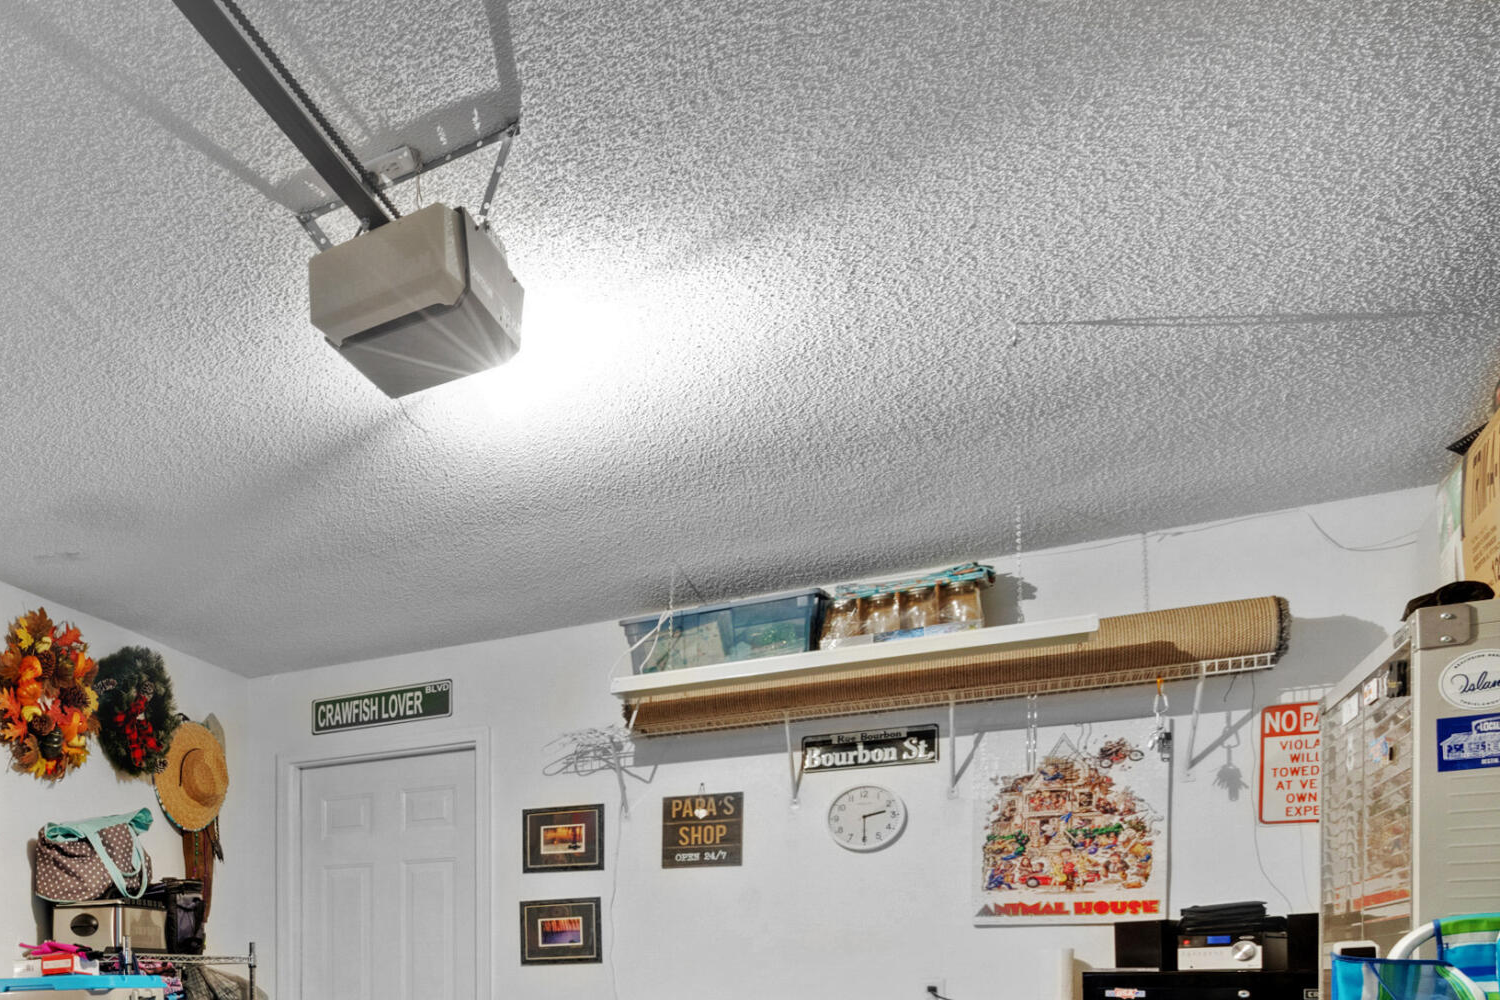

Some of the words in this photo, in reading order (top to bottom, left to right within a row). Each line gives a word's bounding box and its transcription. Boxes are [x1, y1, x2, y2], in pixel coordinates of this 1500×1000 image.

[424, 682, 449, 695] BLVD
[317, 696, 379, 728] CRAWFISH
[381, 690, 423, 719] LOVER
[1264, 709, 1299, 734] NO
[860, 731, 902, 742] Bourbon
[804, 742, 898, 769] Bourbon
[1271, 765, 1320, 778] TOWED
[1275, 780, 1293, 791] AT
[1300, 778, 1317, 790] VE
[1285, 792, 1318, 804] OWN
[671, 795, 735, 818] PAPA'S
[1285, 805, 1320, 817] EXPE
[678, 824, 727, 846] SHOP
[675, 852, 701, 862] OPEN
[703, 849, 728, 861] 24/7
[975, 901, 1070, 917] ANIMAL
[1073, 899, 1160, 915] HOUSE
